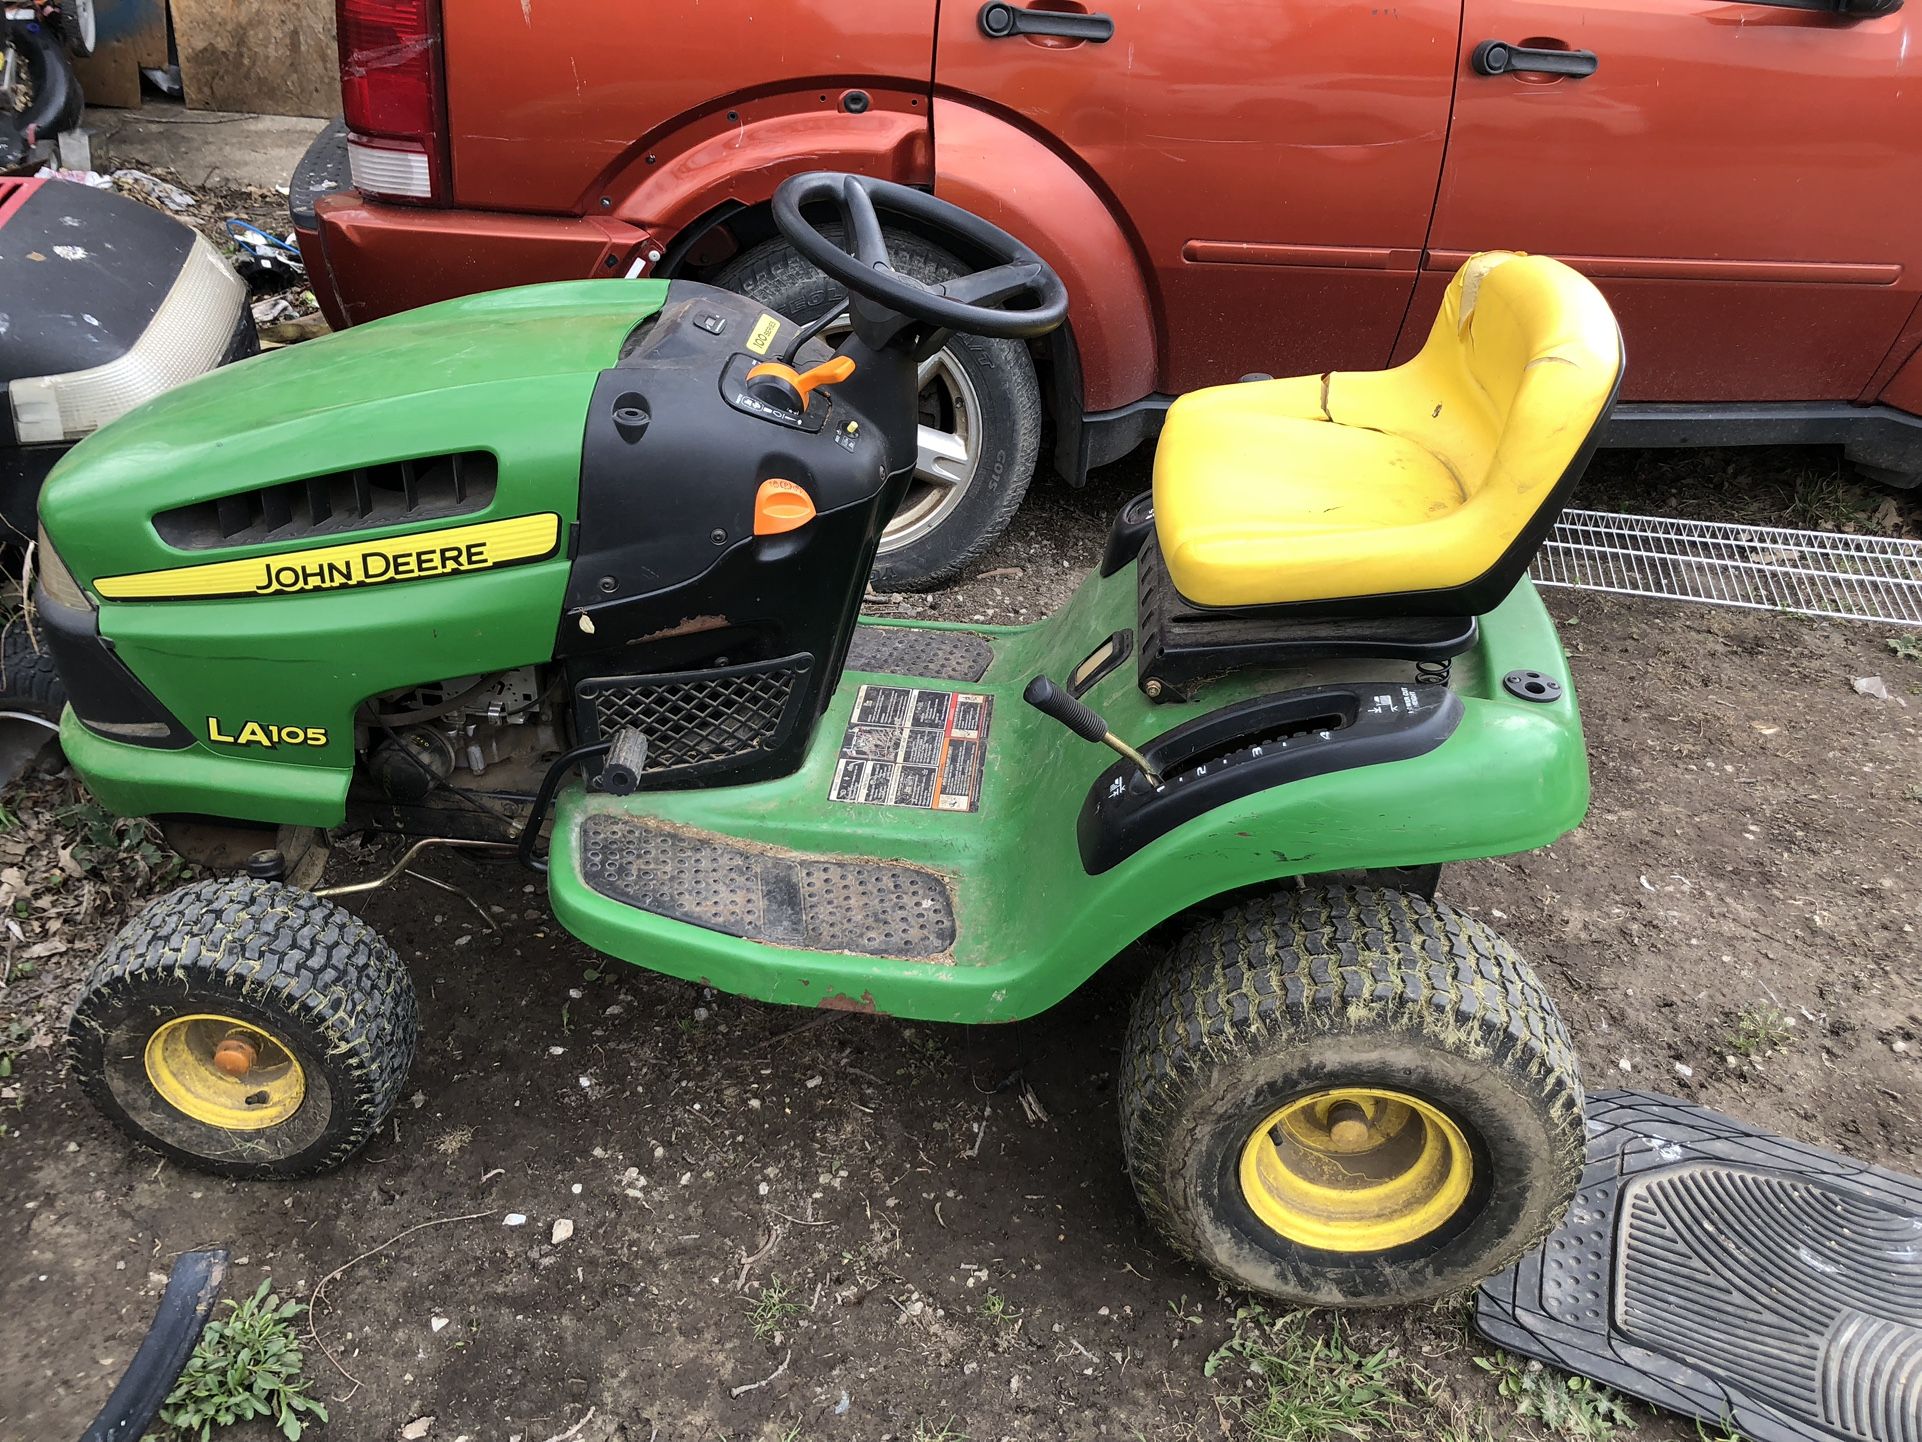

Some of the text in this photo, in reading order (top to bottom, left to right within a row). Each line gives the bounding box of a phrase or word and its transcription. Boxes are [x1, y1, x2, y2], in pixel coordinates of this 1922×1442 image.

[753, 321, 777, 348] 100 SERIES
[256, 542, 489, 591] JOHN DEERE
[1401, 687, 1409, 696] CUT
[207, 716, 328, 747] LA105
[1320, 731, 1331, 740] 4
[1251, 747, 1263, 757] 3
[1196, 765, 1207, 776] 2
